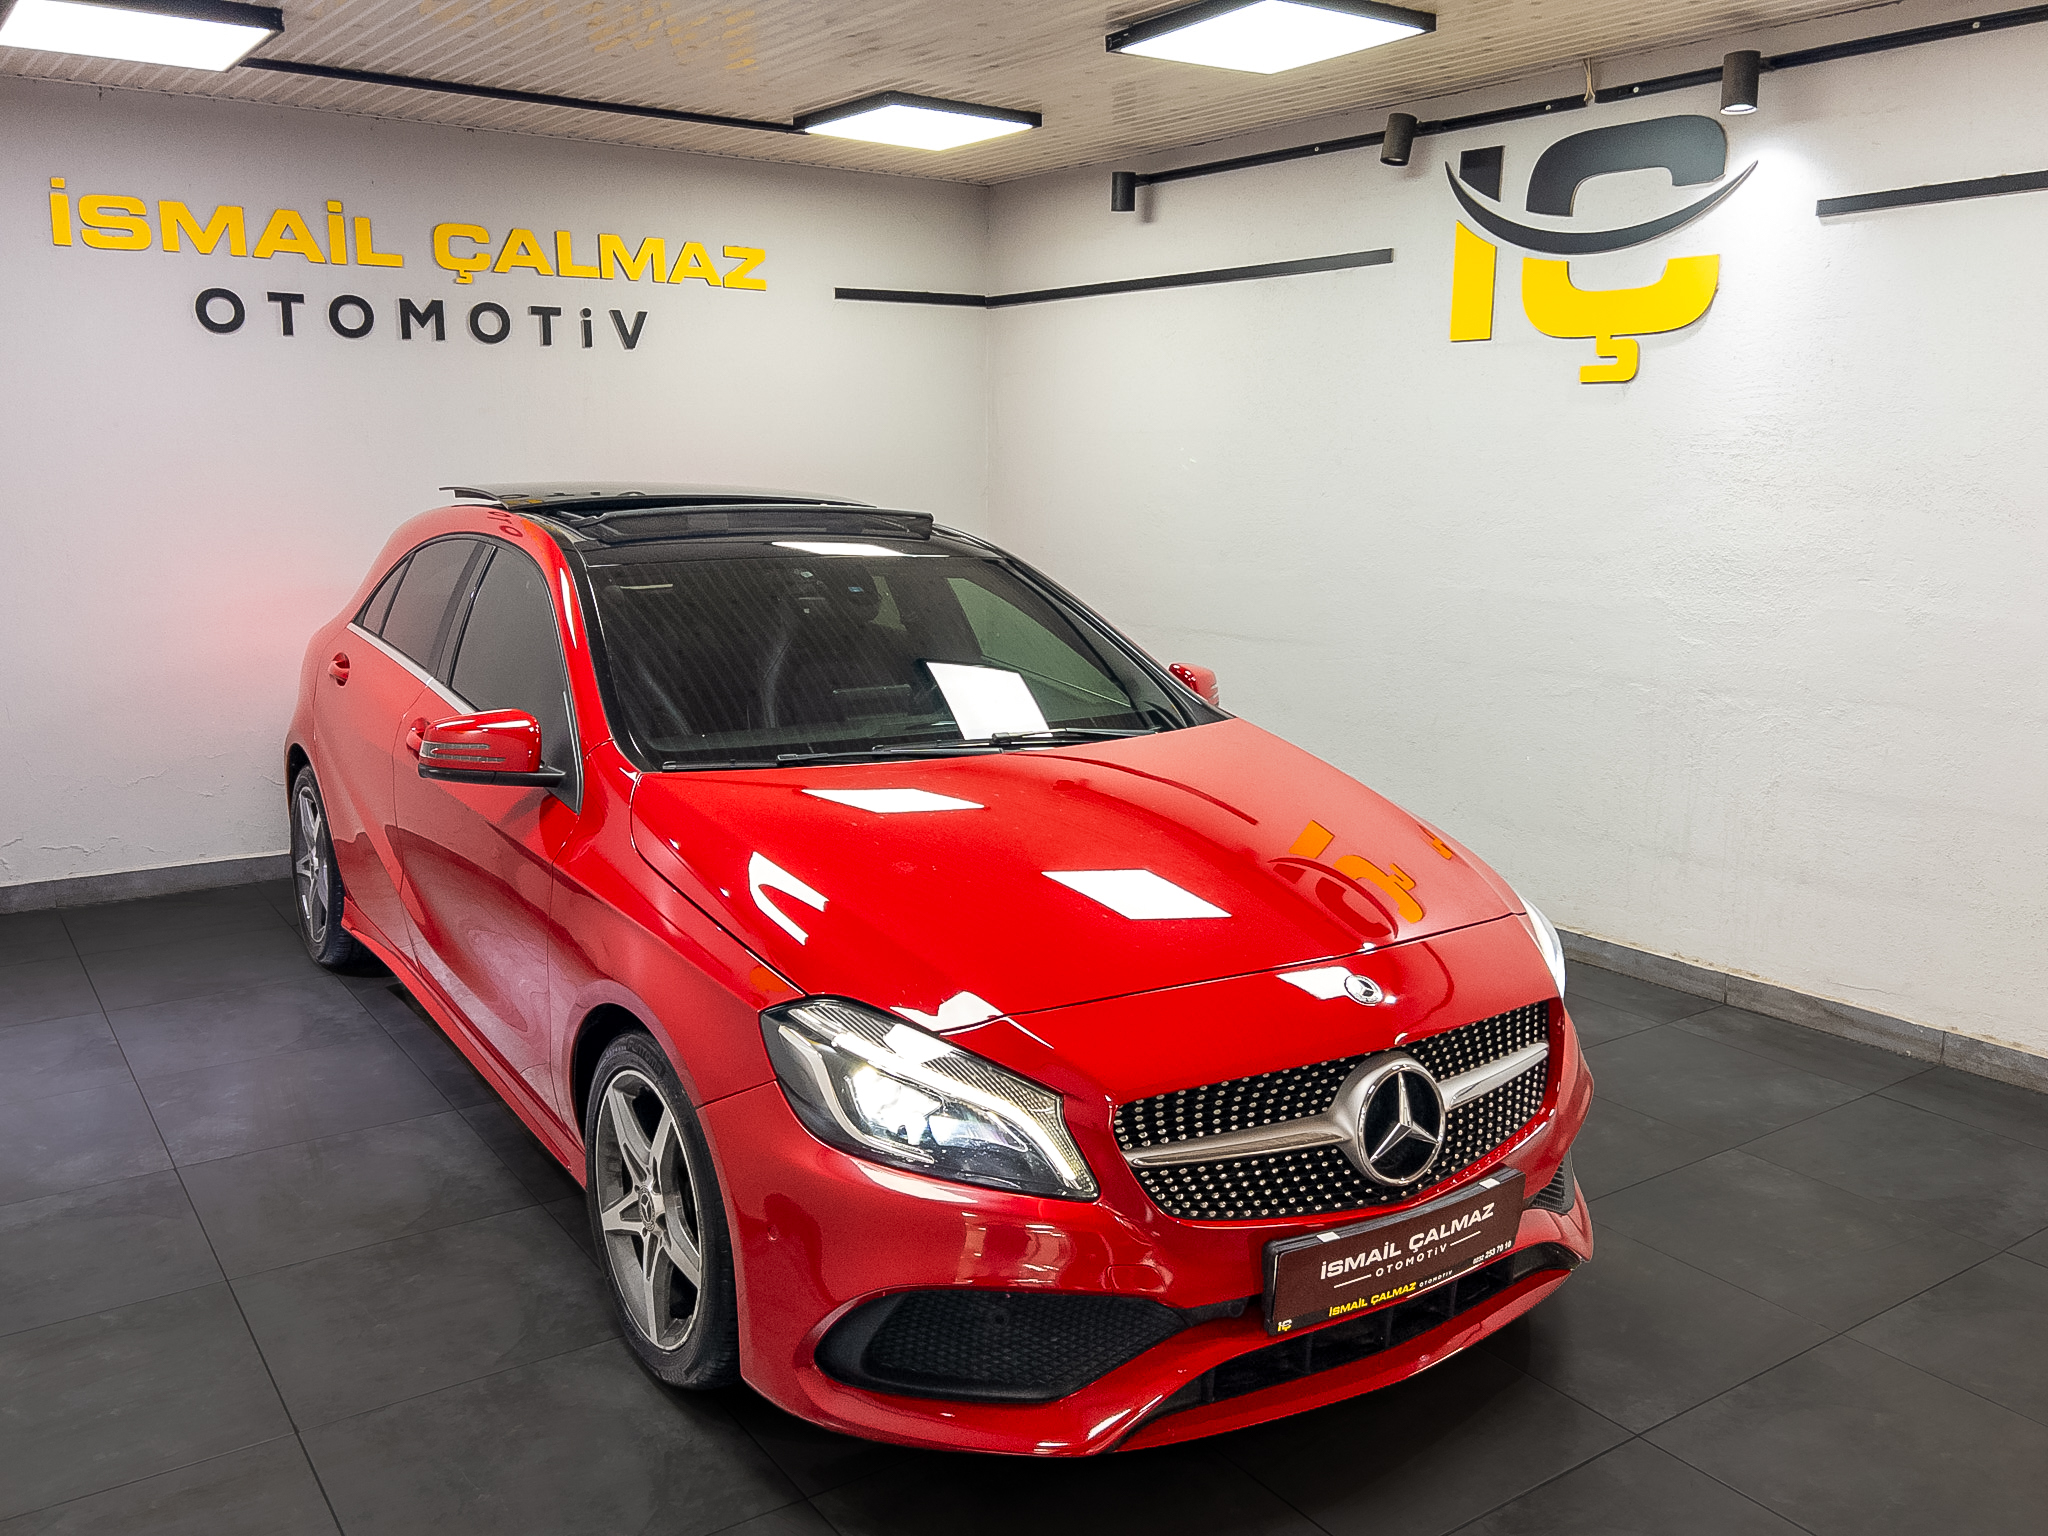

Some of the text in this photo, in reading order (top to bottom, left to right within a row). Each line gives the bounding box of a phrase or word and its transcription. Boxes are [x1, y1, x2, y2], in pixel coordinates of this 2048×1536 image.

[50, 177, 768, 292] İSMAİL ÇALMAZ
[1320, 1202, 1495, 1280] İSMAİL ÇALMAZ
[1370, 1281, 1417, 1305] ÇALMAZ
